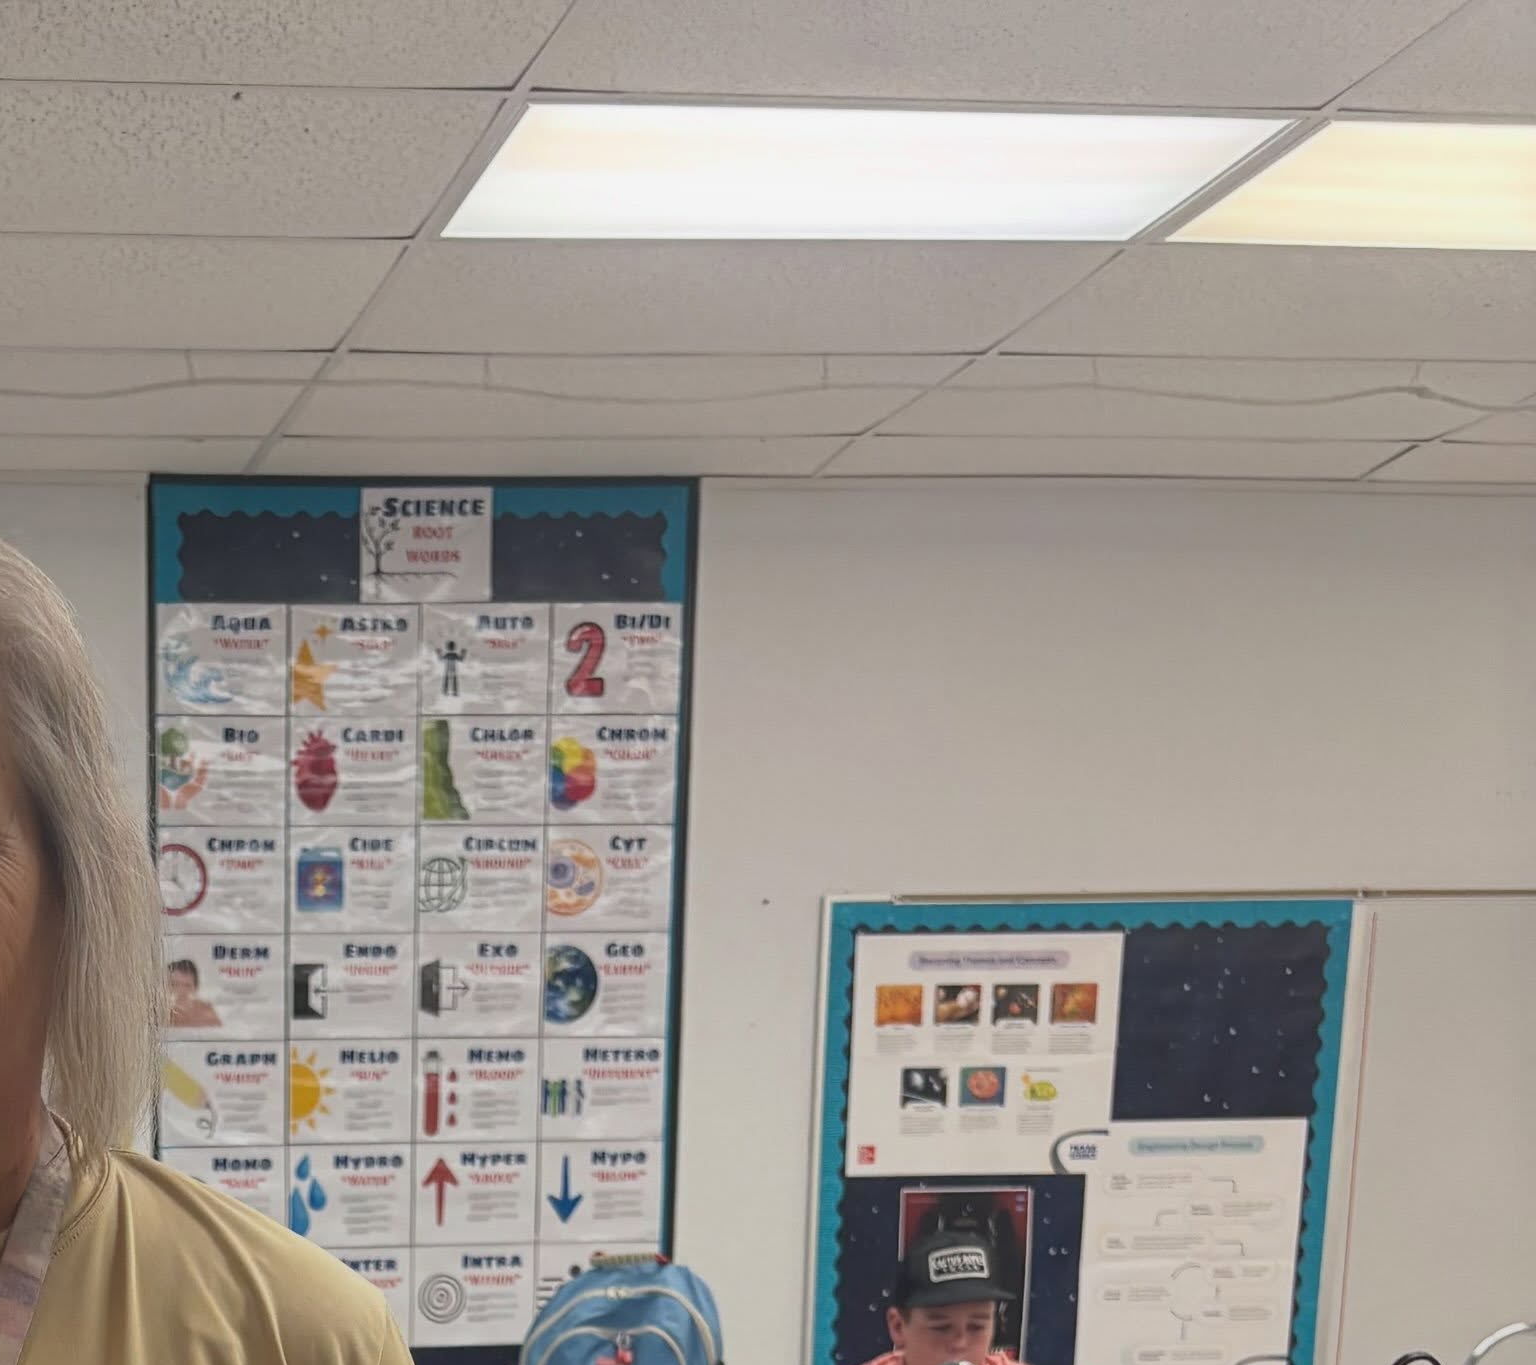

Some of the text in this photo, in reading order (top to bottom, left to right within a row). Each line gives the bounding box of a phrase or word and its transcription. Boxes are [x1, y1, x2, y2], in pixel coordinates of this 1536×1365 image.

[382, 497, 485, 518] SCIENCE
[223, 727, 260, 744] BIO
[477, 942, 519, 958] EXO
[605, 942, 645, 958] GEO
[206, 1051, 278, 1067] GRAPH
[340, 1050, 400, 1065] HELIO
[583, 1048, 661, 1064] HETERO
[461, 1255, 523, 1270] INTRA
